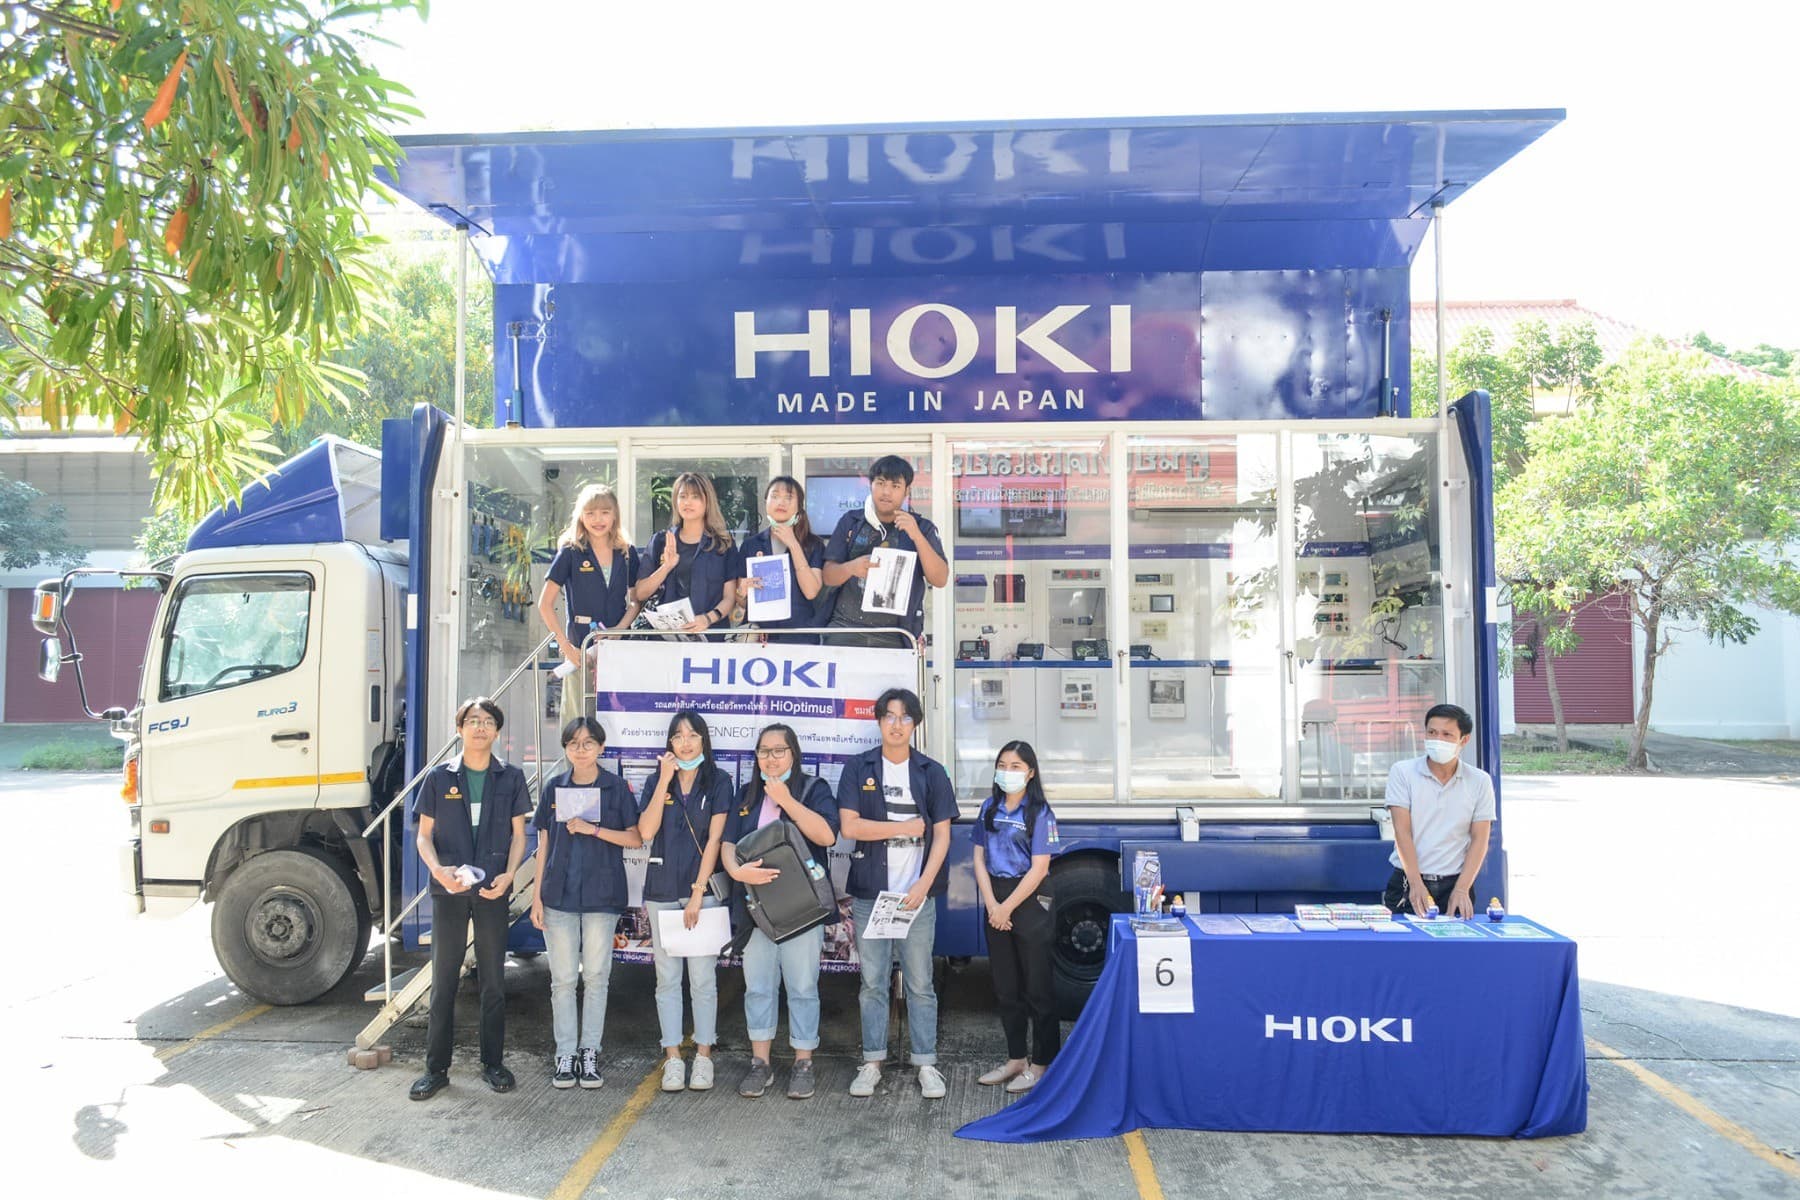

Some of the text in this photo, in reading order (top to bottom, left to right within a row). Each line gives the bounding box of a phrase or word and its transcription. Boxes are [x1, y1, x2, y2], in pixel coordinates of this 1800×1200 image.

[734, 303, 1131, 379] HIOKI
[777, 388, 1084, 413] MADE IN JAPAN
[681, 657, 837, 689] HIOKI
[770, 700, 834, 715] HiOptimus
[148, 716, 190, 735] FC9J
[707, 726, 756, 738] ENNECT
[1154, 957, 1175, 987] 6
[1264, 1014, 1413, 1044] HIOKI
